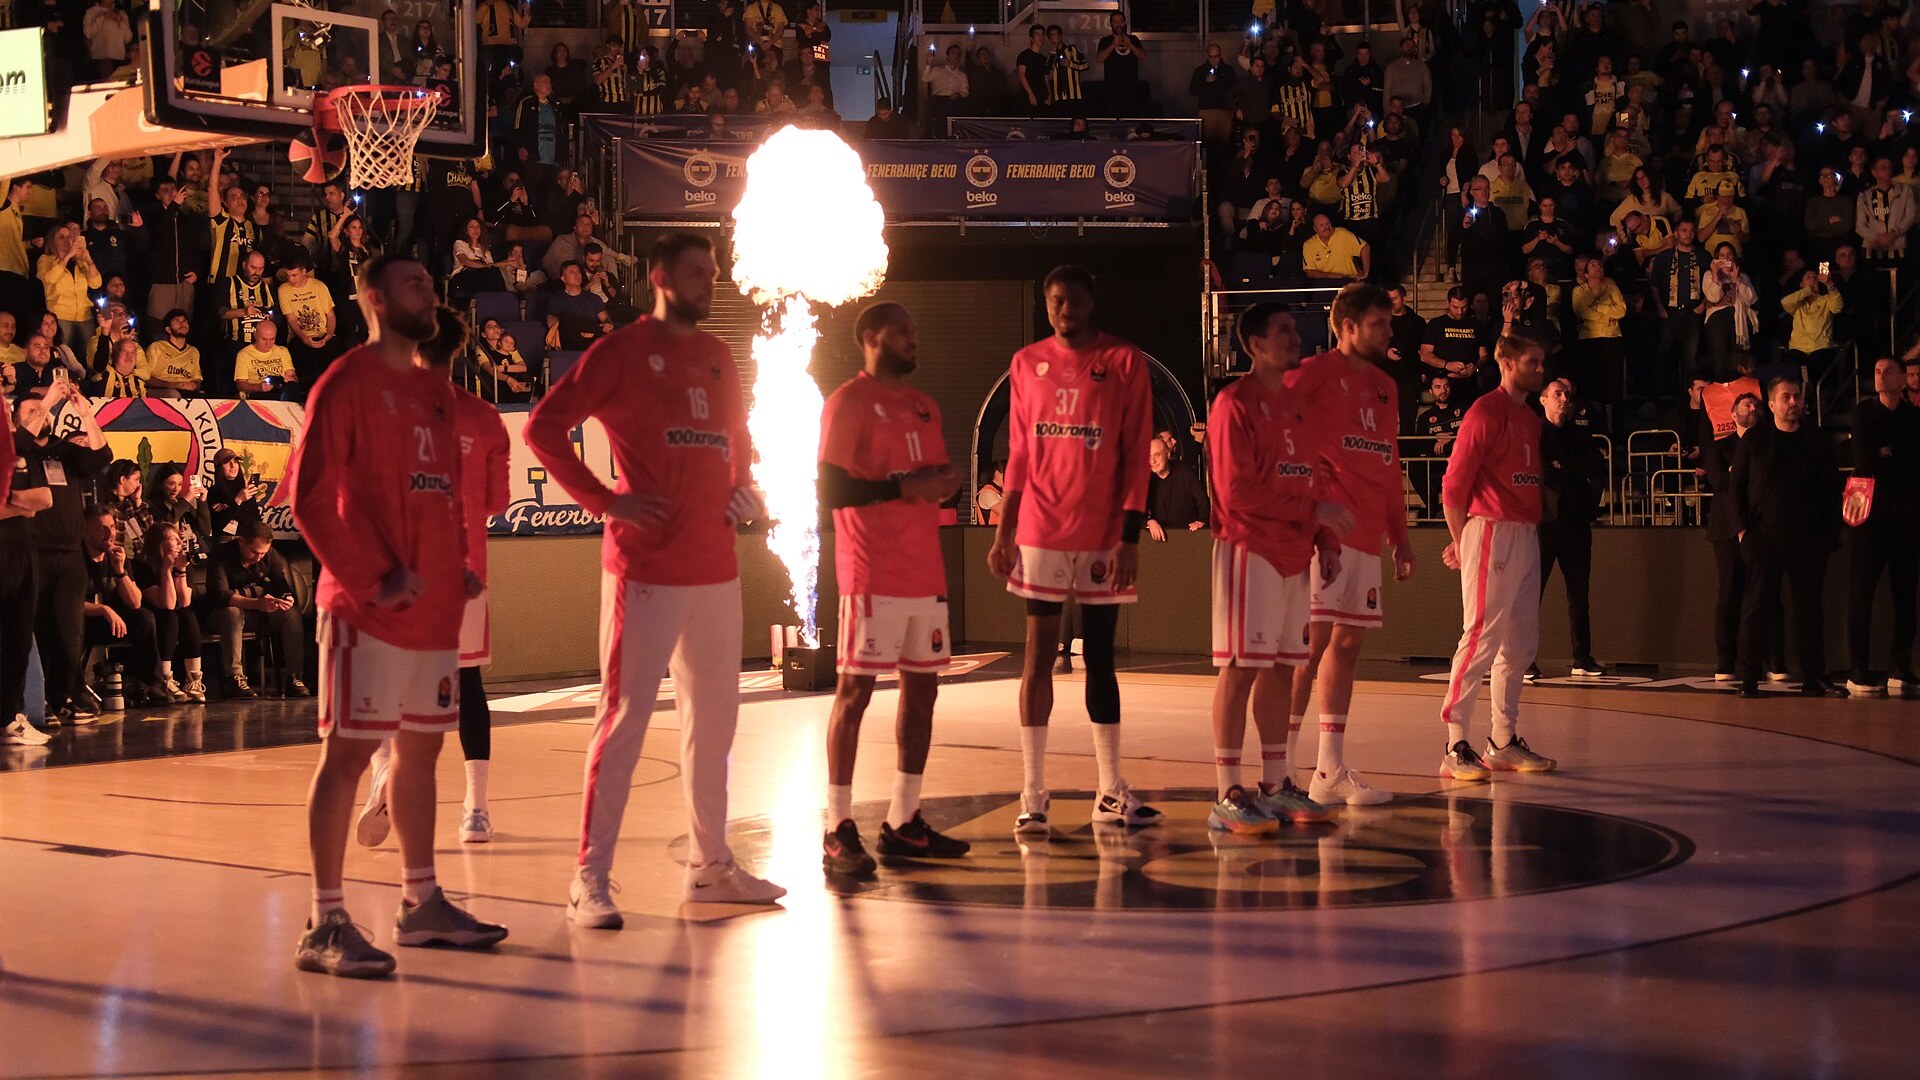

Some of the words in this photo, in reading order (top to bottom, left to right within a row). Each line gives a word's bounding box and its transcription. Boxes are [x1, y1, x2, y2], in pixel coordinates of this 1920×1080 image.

[866, 163, 929, 181] FENERBAHÇE
[930, 163, 958, 179] BEKO
[1006, 163, 1068, 181] FENERBAHÇE
[1069, 163, 1097, 179] BEKO
[684, 190, 717, 202] beko
[966, 190, 998, 203] beko
[1104, 191, 1136, 203] beko
[686, 386, 710, 421] 16
[1055, 387, 1080, 416] 37
[413, 425, 438, 462] 21
[904, 431, 922, 463] 11
[1283, 429, 1295, 456] 5
